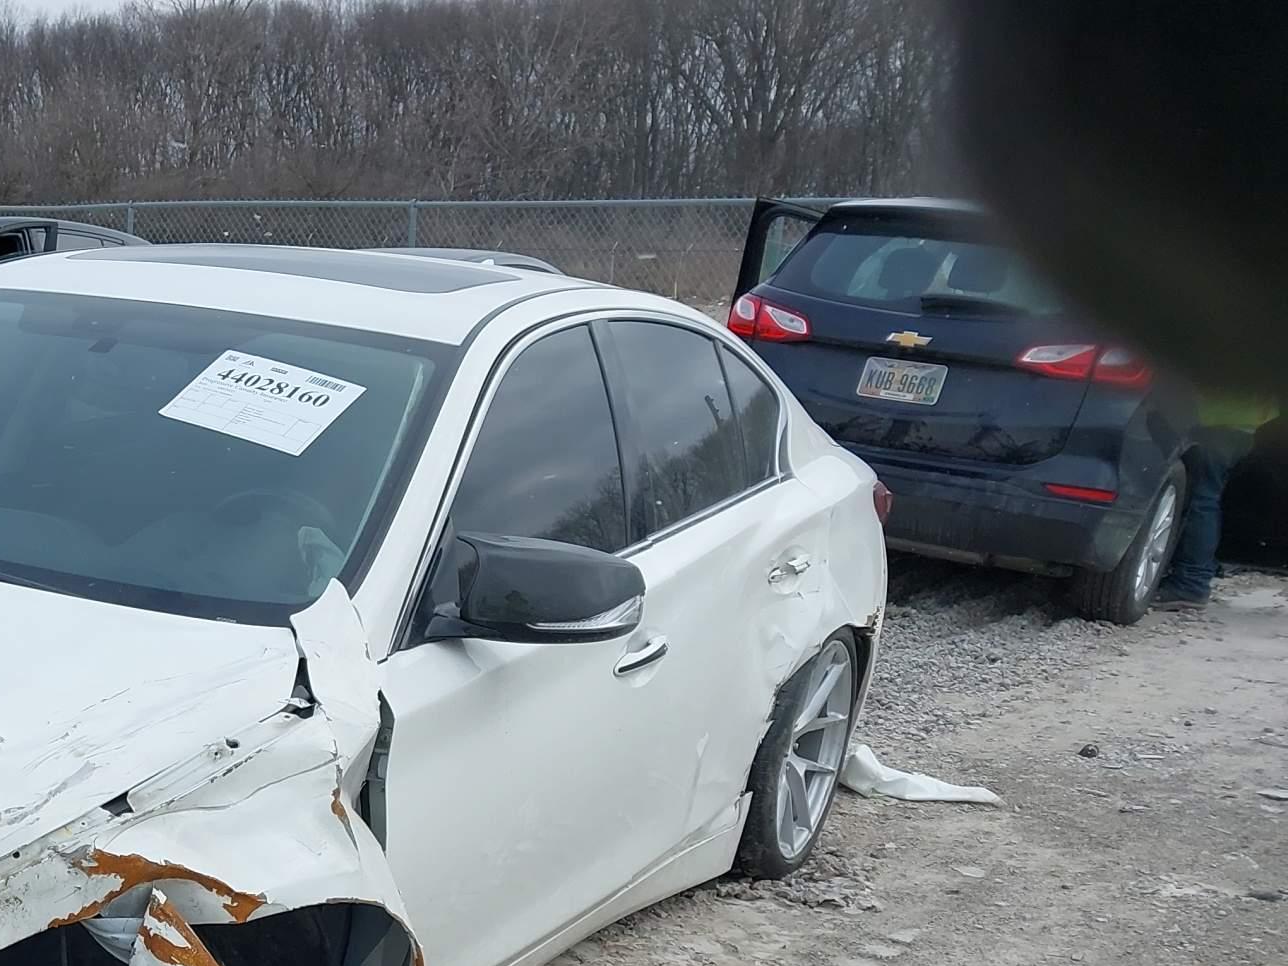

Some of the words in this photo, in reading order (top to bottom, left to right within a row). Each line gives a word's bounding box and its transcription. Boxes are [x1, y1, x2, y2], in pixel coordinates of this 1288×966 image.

[217, 368, 331, 408] 44028160
[866, 368, 896, 391] KUB
[898, 373, 937, 396] 9668
